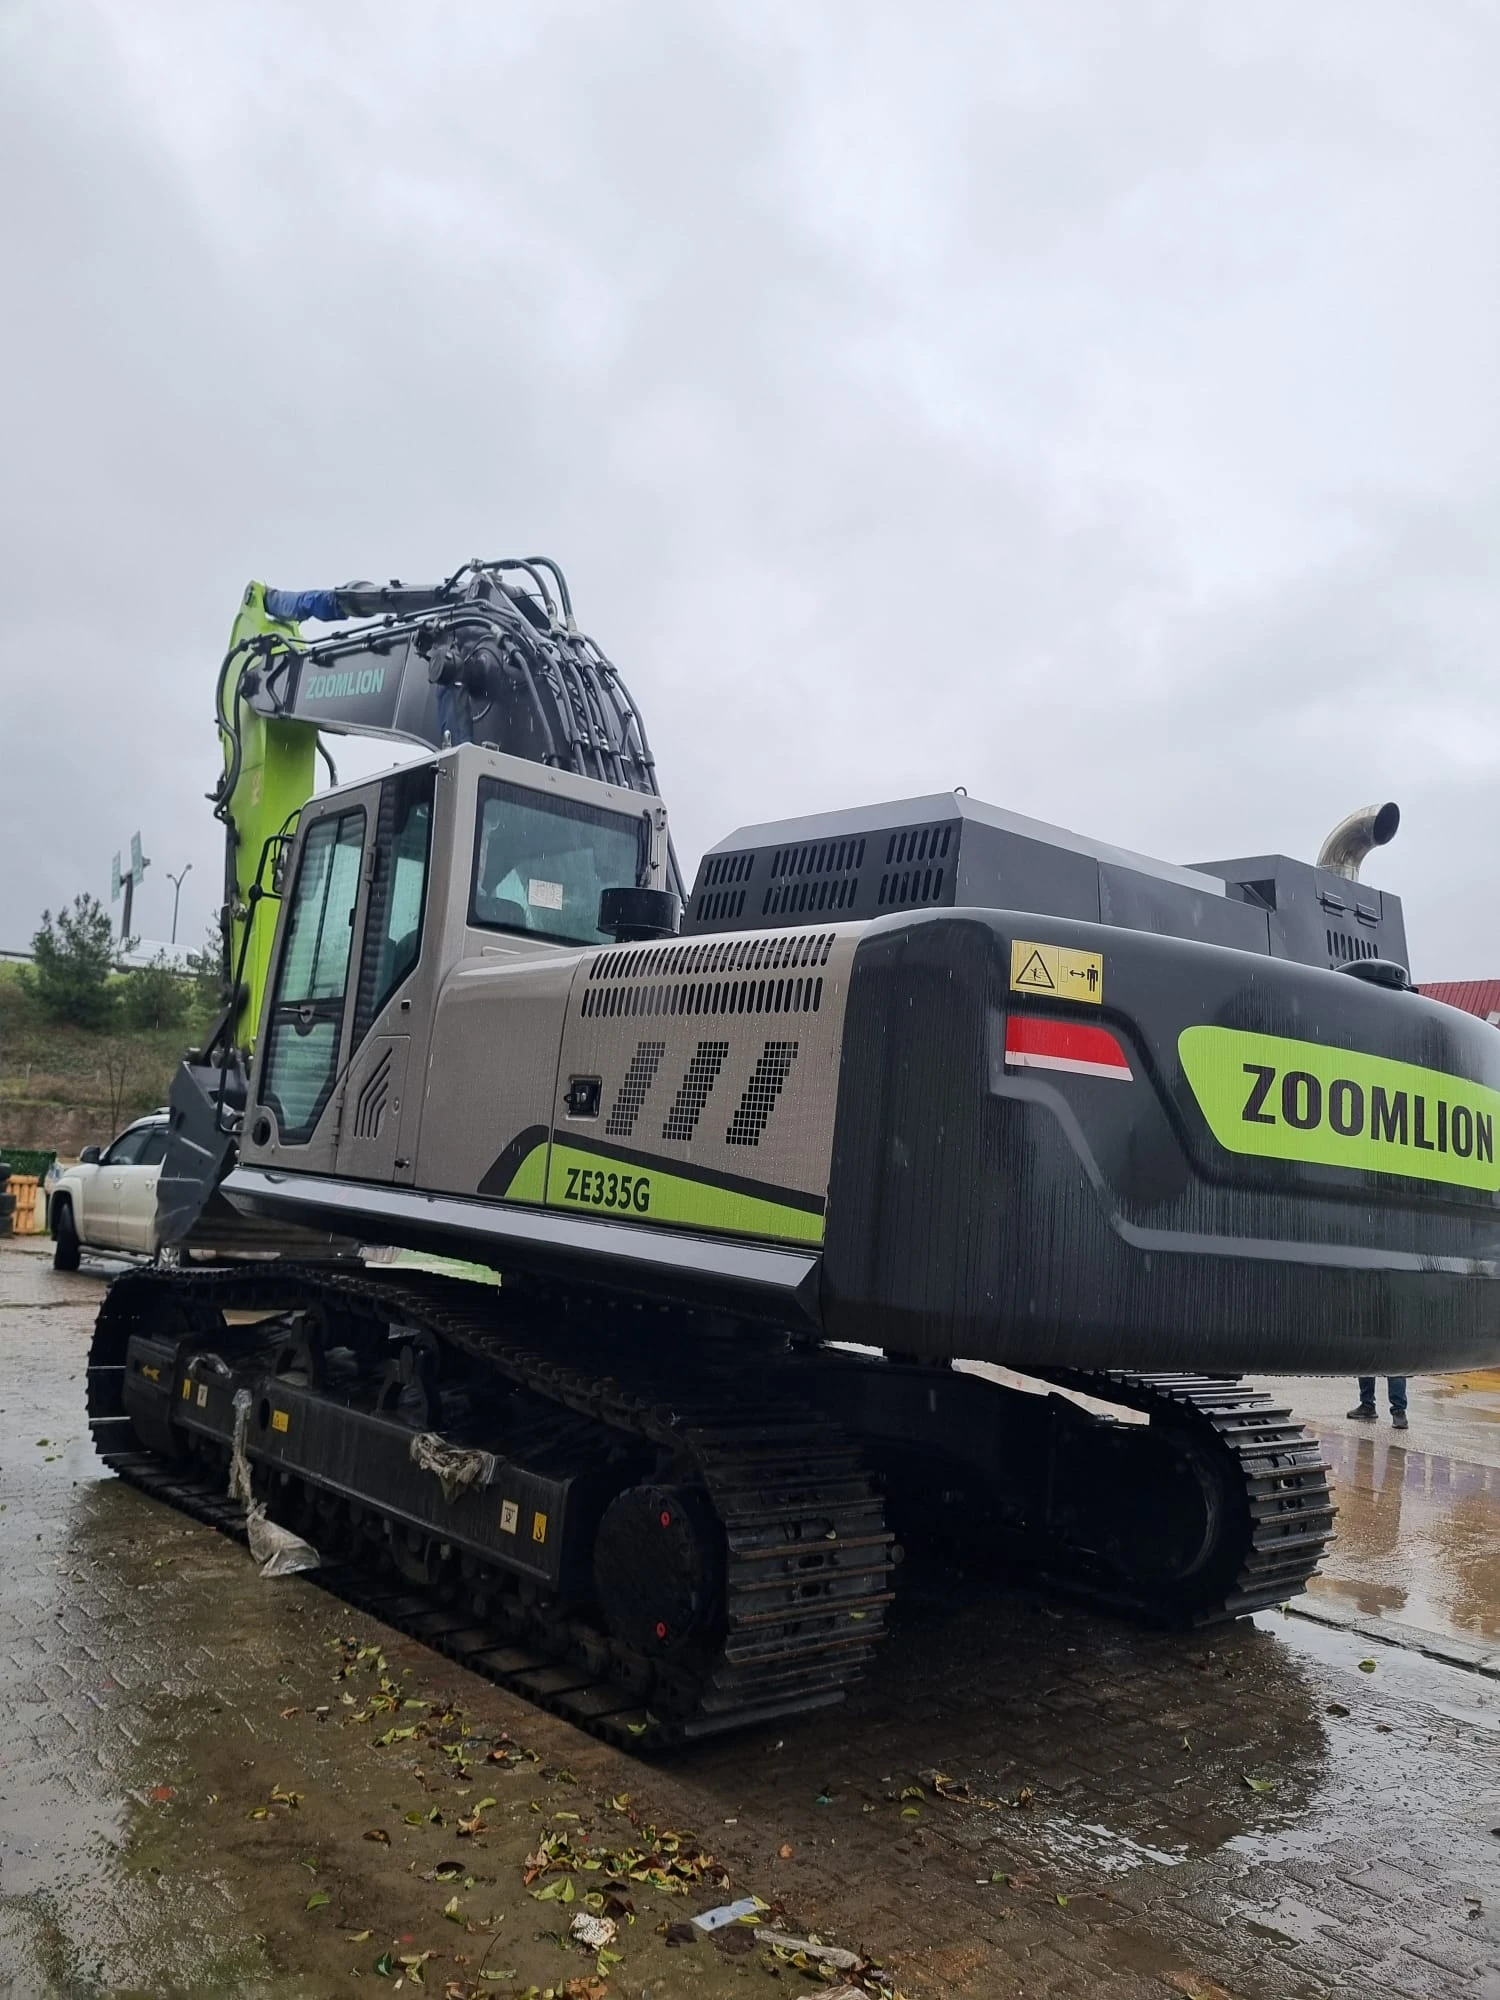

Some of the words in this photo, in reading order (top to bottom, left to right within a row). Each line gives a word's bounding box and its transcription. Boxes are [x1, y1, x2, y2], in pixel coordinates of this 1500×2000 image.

[305, 667, 385, 700] ZOOMLION
[1242, 1063, 1493, 1164] ZOOMLION
[565, 1168, 650, 1212] ZE335G
